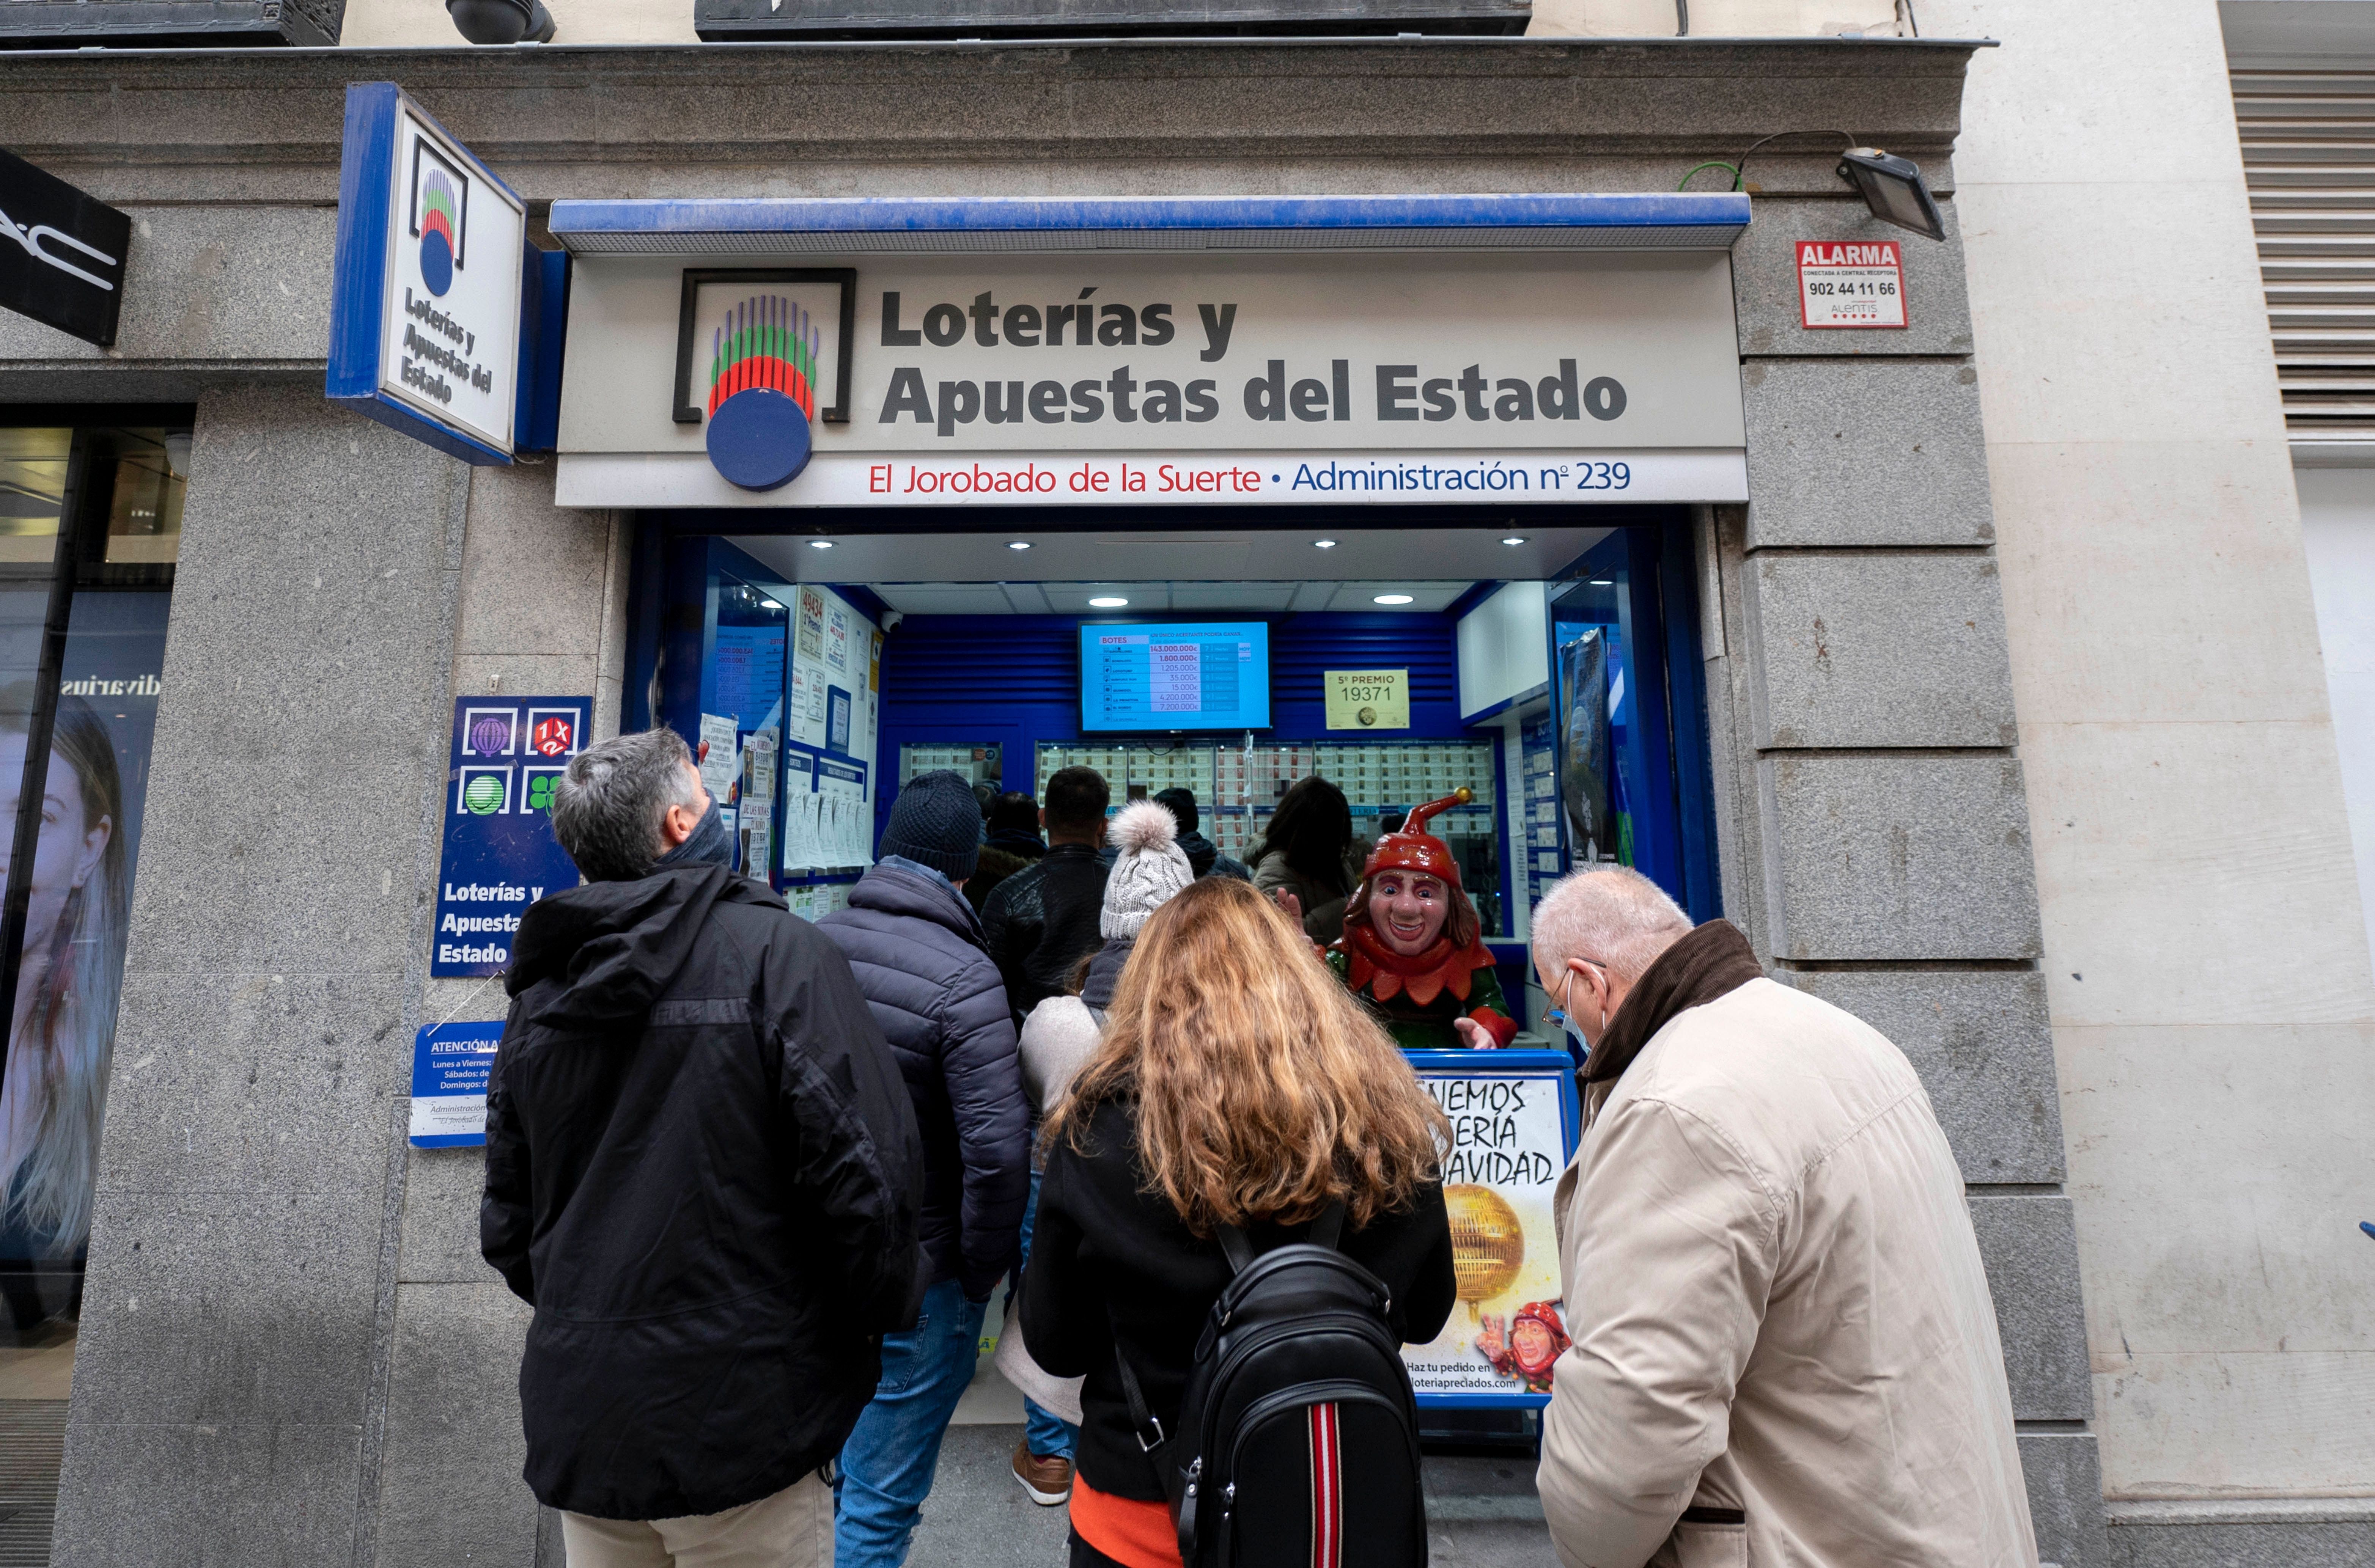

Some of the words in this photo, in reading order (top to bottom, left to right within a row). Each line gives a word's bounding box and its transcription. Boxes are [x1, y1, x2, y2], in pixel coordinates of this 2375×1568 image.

[1801, 245, 1897, 265] ALARMA
[1809, 283, 1834, 295] 902
[1839, 283, 1854, 295] 44
[1859, 283, 1874, 295] 11
[1879, 283, 1895, 295] 66
[405, 287, 464, 344] Loterías
[465, 331, 475, 356] y
[881, 287, 1175, 347] Loterías
[1197, 303, 1238, 363] y
[403, 323, 470, 380] Apuestas
[472, 363, 492, 394] del
[401, 355, 452, 403] Estado
[878, 364, 1219, 437] Apuestas
[1243, 359, 1351, 422] del
[1376, 358, 1628, 422] Estado
[869, 465, 892, 493] El
[903, 463, 1056, 494] Jorobado
[1068, 462, 1109, 492] de
[1121, 463, 1147, 492] la
[1158, 465, 1261, 493] Suerte
[1291, 461, 1529, 492] Administración
[1576, 462, 1631, 490] 239
[1352, 675, 1395, 684] PREMIO
[1341, 687, 1390, 701] 19371
[445, 881, 525, 902] Loterías
[531, 886, 543, 903] y
[439, 943, 507, 963] Estado
[431, 1039, 488, 1053] ATENCIÓN
[440, 1081, 481, 1090] Domingos:
[1416, 1080, 1526, 1112] NEMOS
[431, 1104, 486, 1113] Administración
[1407, 1362, 1425, 1372] Haz
[1427, 1363, 1438, 1372] tu
[1441, 1362, 1475, 1375] pedido
